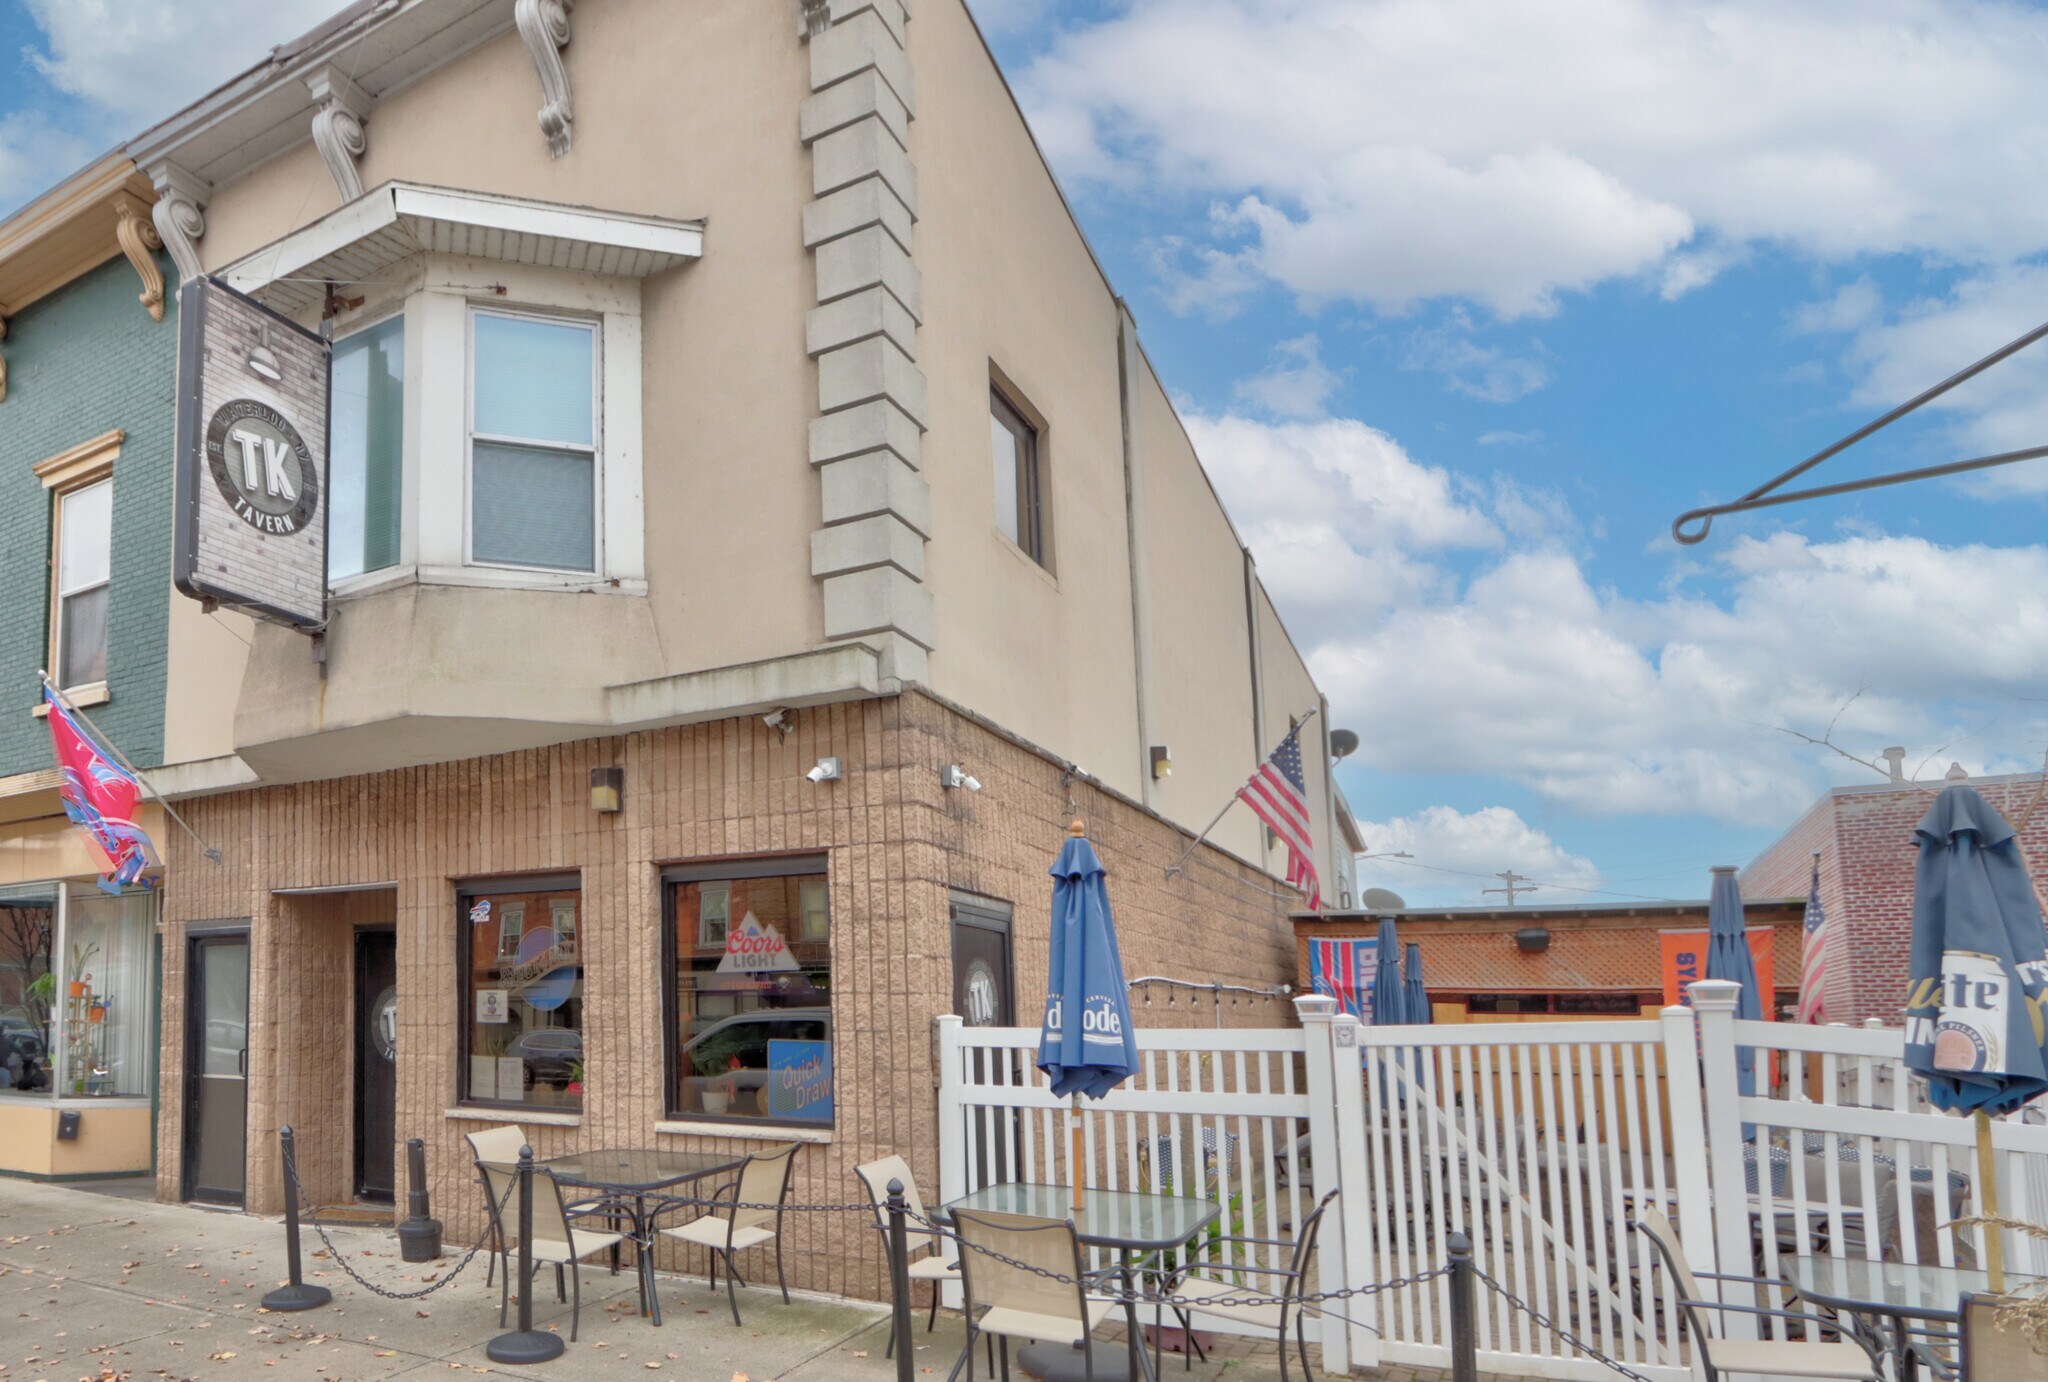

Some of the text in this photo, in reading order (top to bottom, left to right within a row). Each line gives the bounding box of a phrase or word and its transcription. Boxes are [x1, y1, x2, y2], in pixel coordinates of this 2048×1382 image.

[215, 402, 287, 431] WATERLOO
[232, 429, 297, 501] TK
[234, 496, 295, 533] TAVERN
[726, 929, 785, 954] Coors
[733, 953, 777, 968] LIGHT
[969, 979, 993, 1023] TK
[383, 1005, 397, 1041] T
[1083, 1003, 1122, 1034] ode
[782, 1054, 821, 1089] Quick
[796, 1076, 833, 1110] Draw
